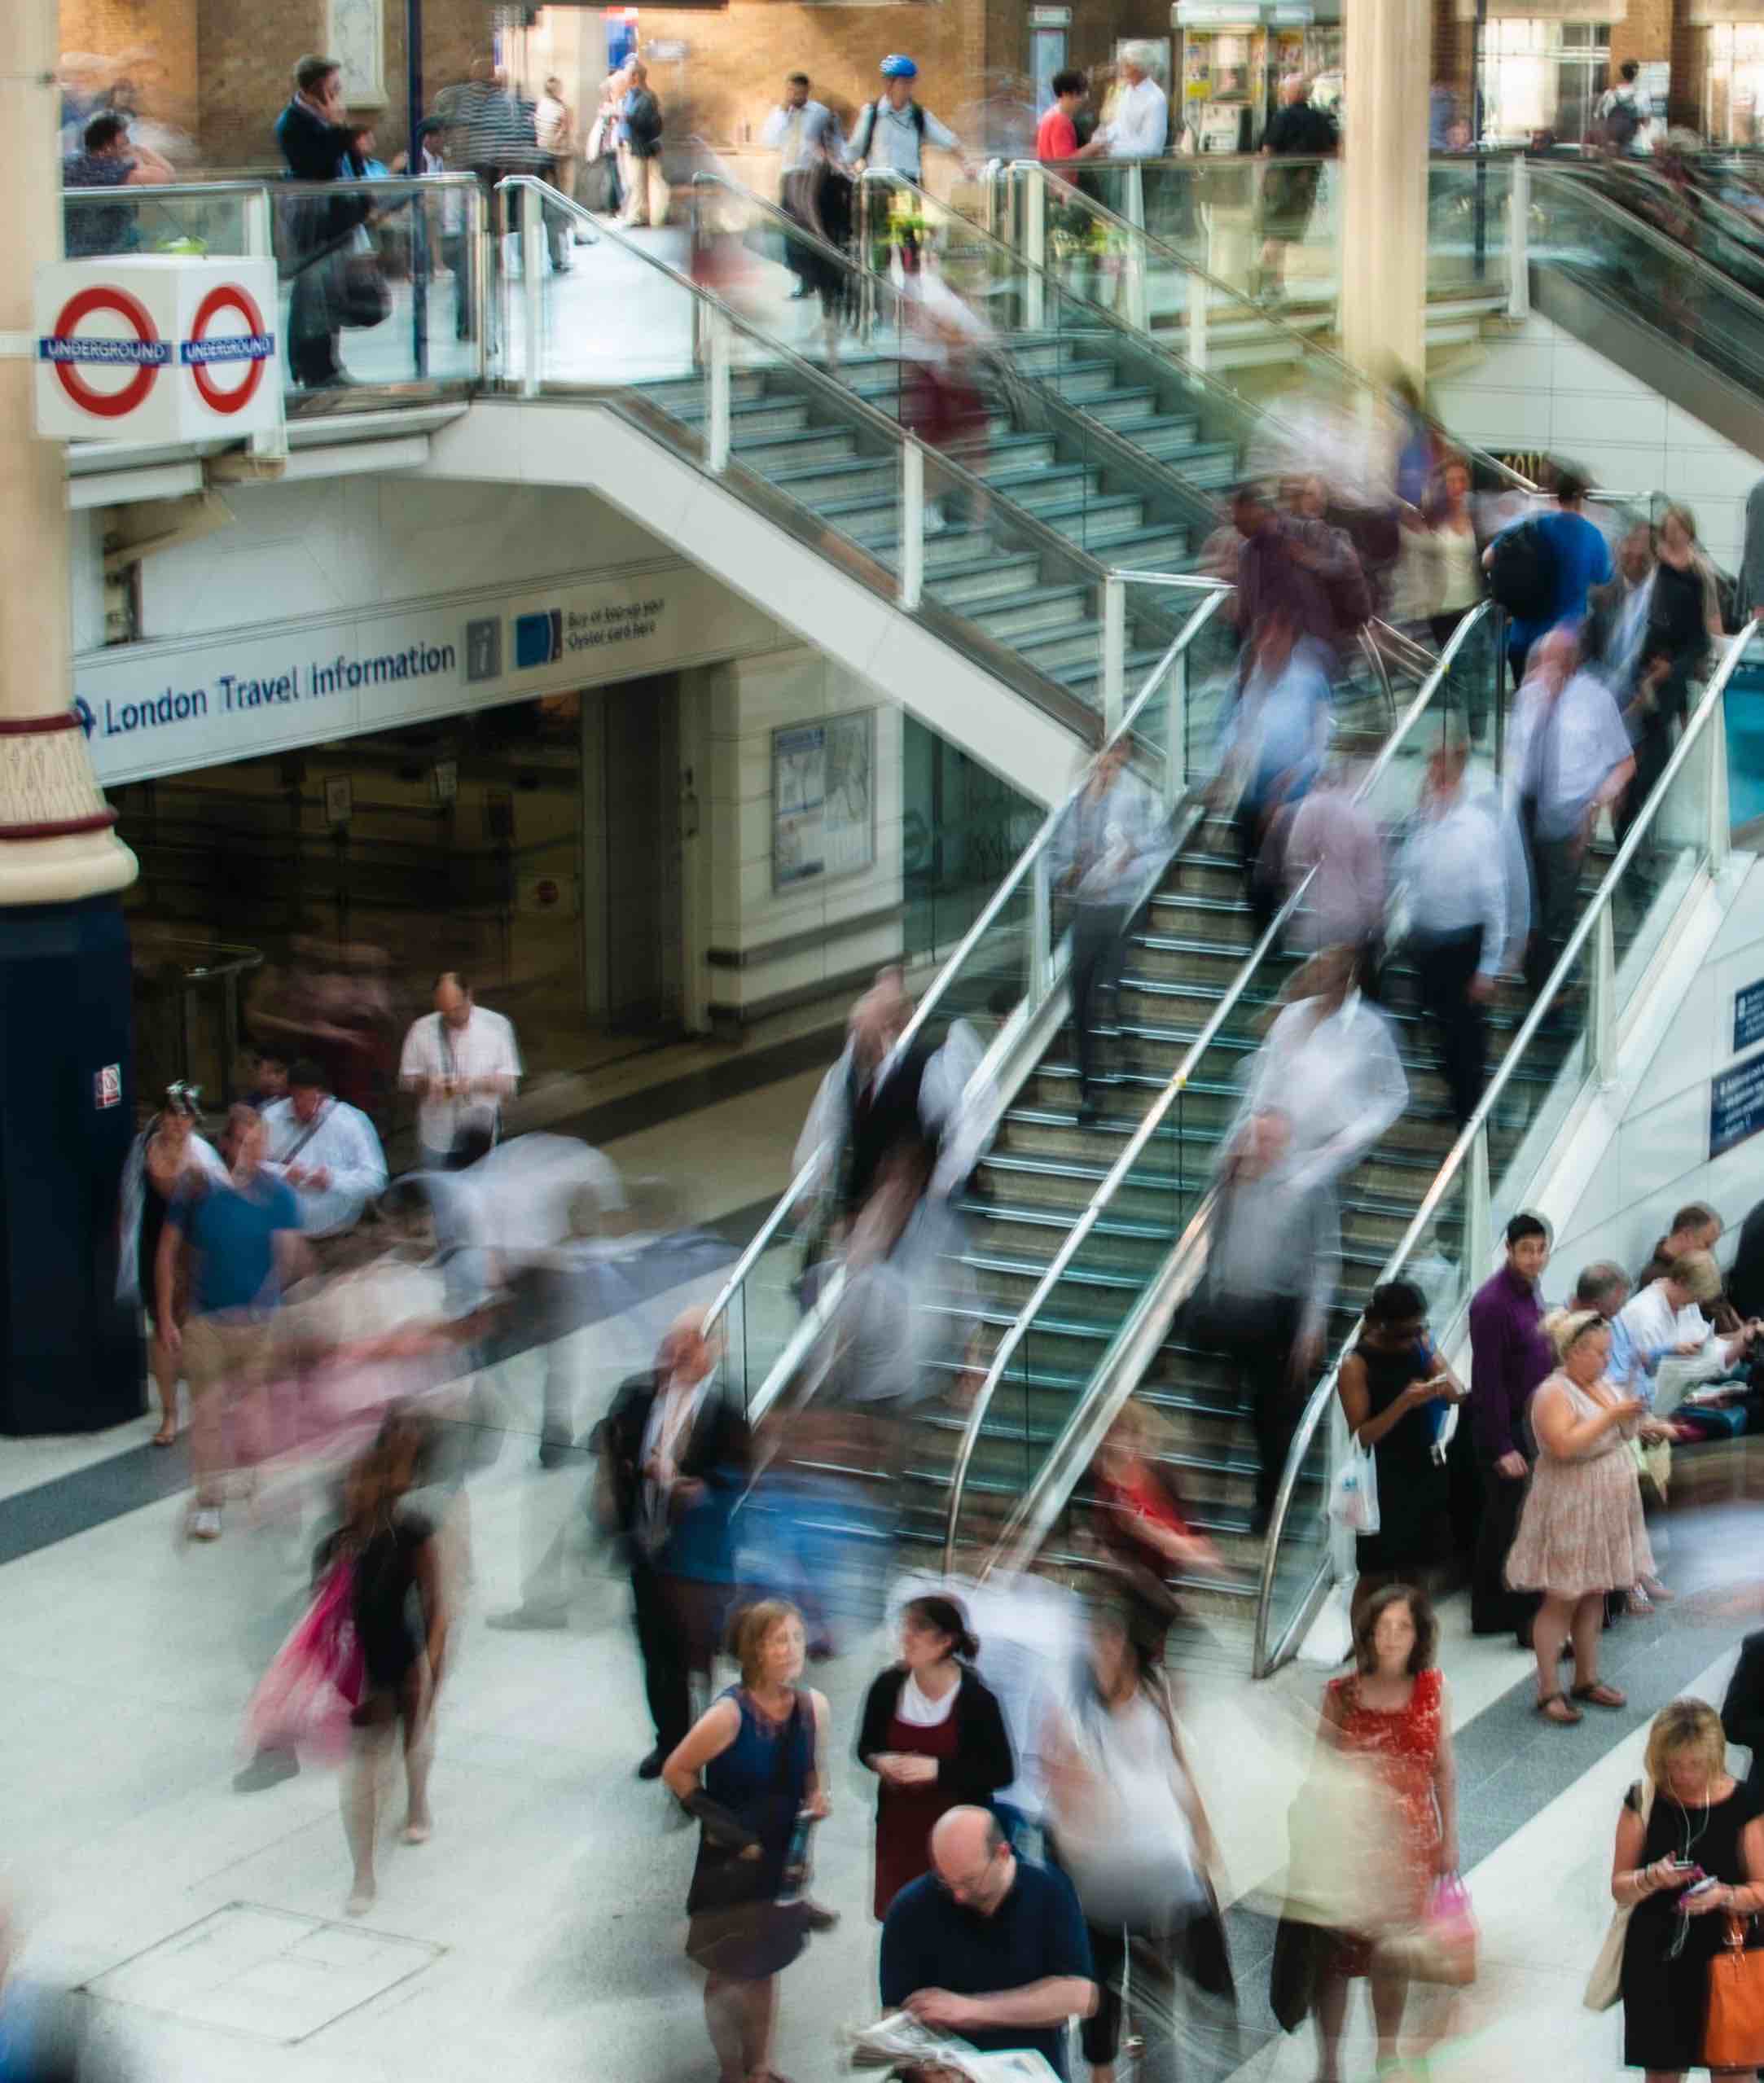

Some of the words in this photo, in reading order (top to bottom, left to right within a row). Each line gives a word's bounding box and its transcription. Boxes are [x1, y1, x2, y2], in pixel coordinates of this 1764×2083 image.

[47, 338, 165, 359] UNDERGROUND
[186, 335, 270, 357] UNDERGROUND
[103, 687, 208, 737] London
[217, 665, 300, 711] Travel
[311, 641, 456, 697] Information
